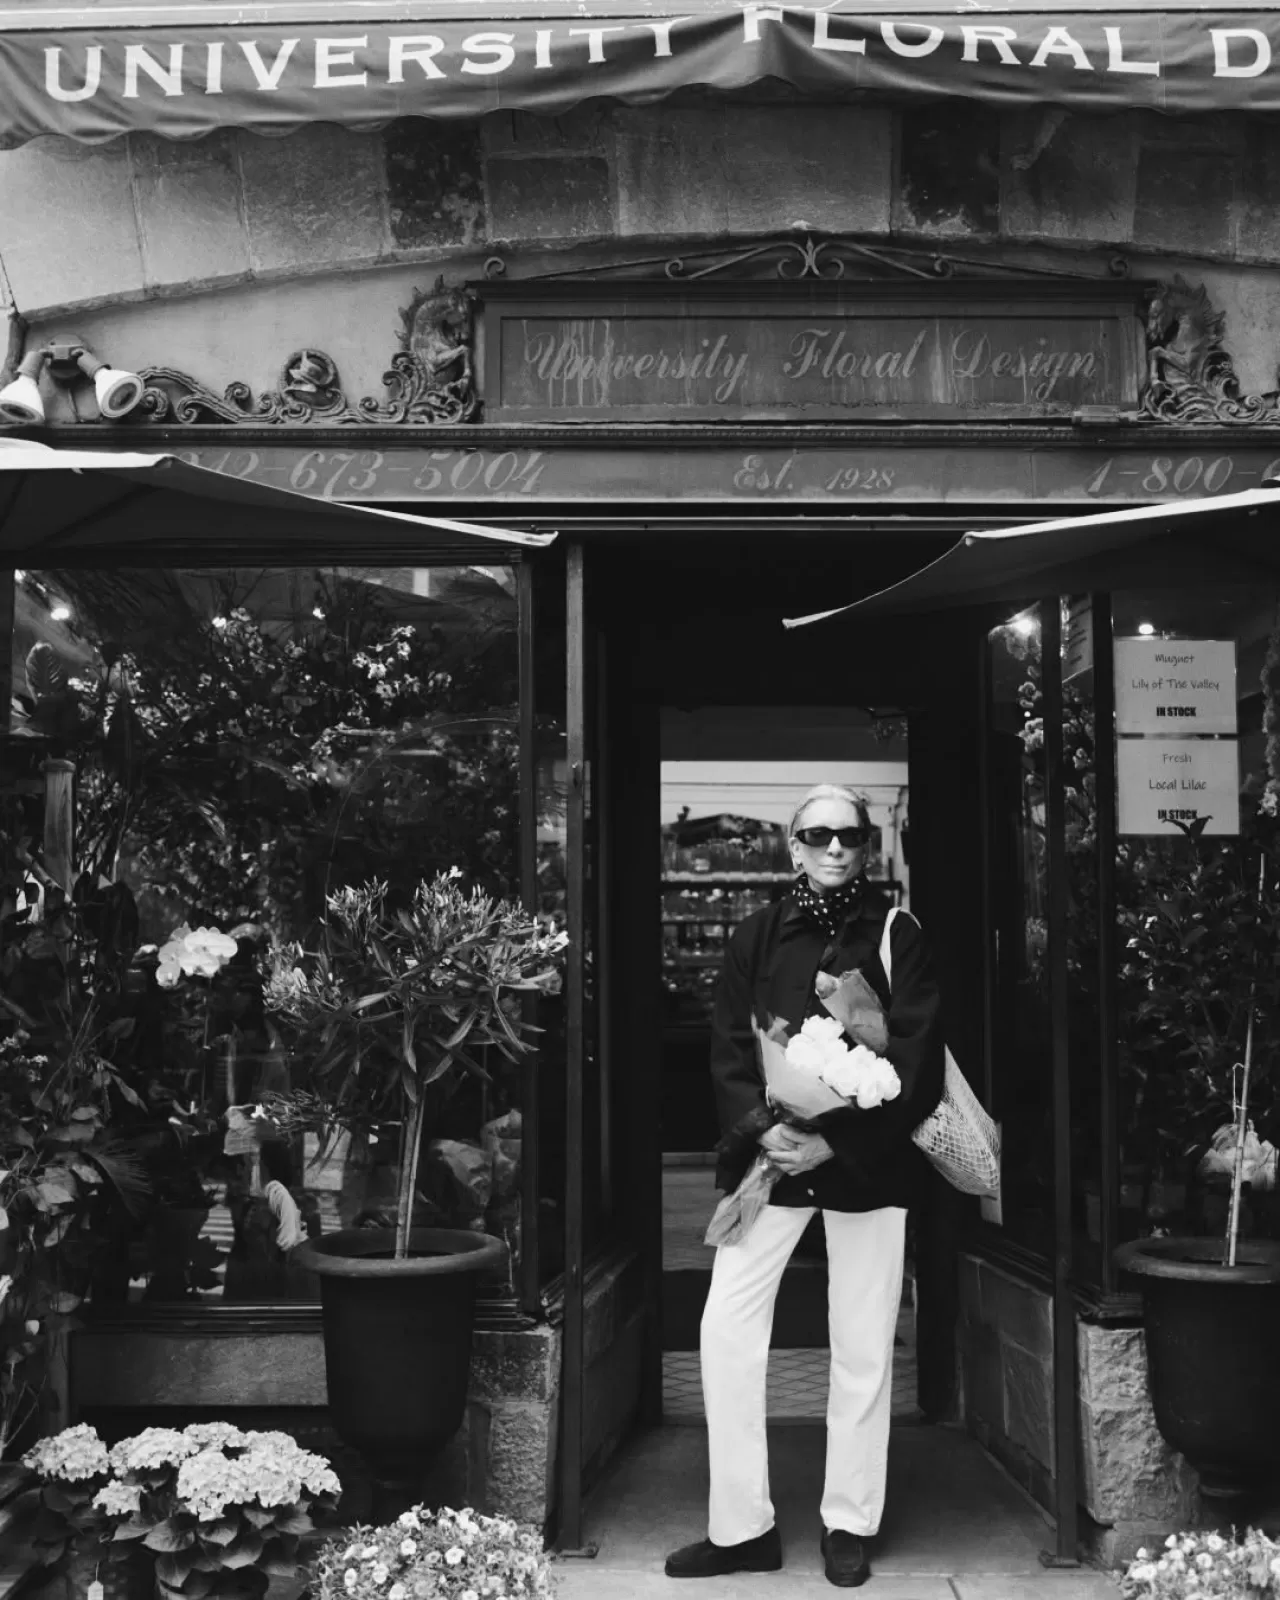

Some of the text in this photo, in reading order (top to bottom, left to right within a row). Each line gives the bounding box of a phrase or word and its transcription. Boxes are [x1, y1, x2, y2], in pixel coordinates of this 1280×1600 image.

[43, 16, 693, 102] UNIVERSITY
[742, 7, 1161, 77] FLORAL
[523, 328, 1097, 402] University Floral Design
[733, 454, 895, 491] Est. 1928
[1155, 653, 1195, 667] Muguet
[1132, 678, 1220, 691] Lily of The Valley
[1156, 706, 1197, 717] IN STOCK
[1162, 753, 1192, 764] Fresh
[1149, 779, 1207, 791] Local Lilac
[1157, 809, 1198, 820] IN STOCK
